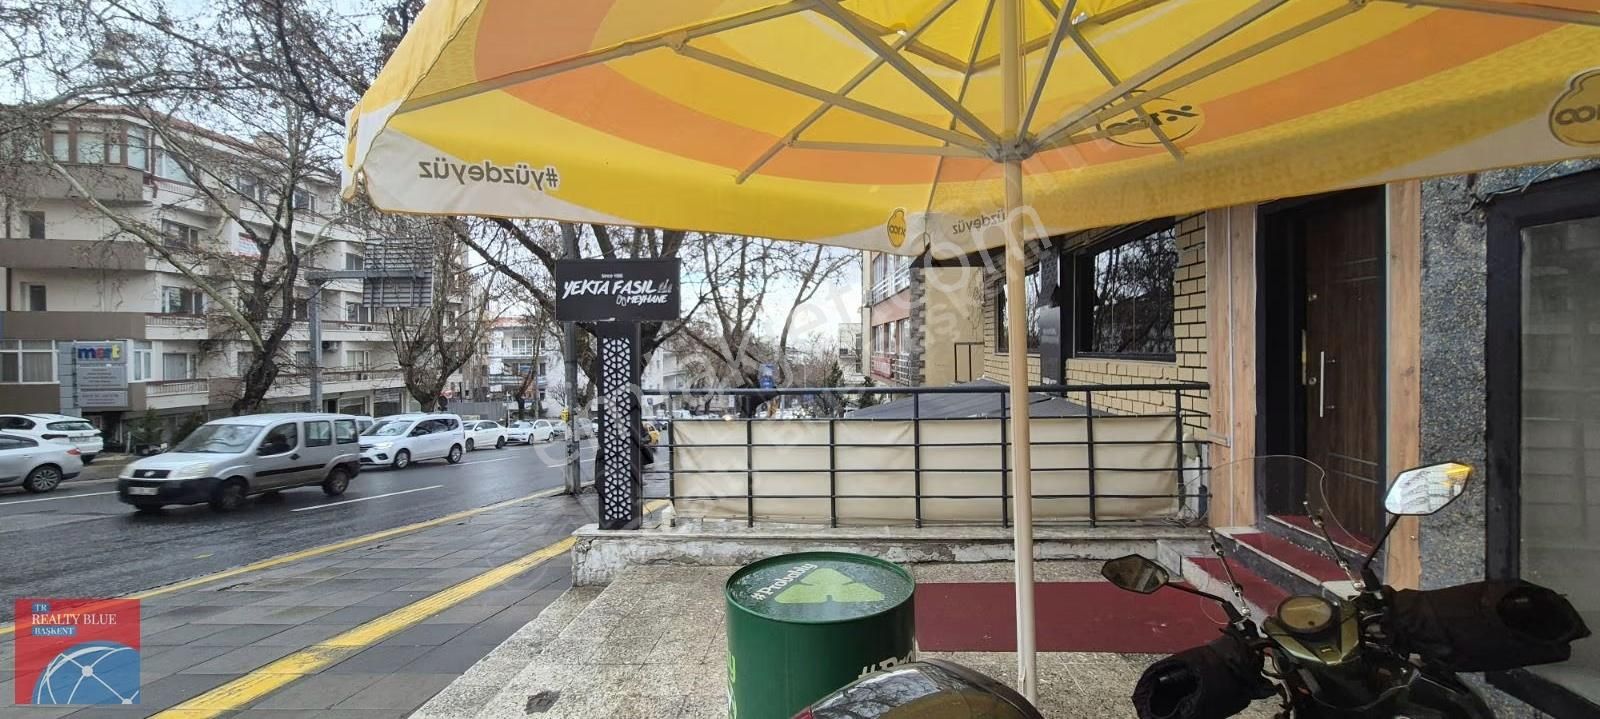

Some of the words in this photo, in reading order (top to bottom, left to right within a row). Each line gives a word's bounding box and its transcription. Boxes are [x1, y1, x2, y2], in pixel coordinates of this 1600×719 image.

[562, 279, 610, 300] YEKTA
[612, 279, 657, 295] FASIL
[626, 294, 668, 306] MEYHANE
